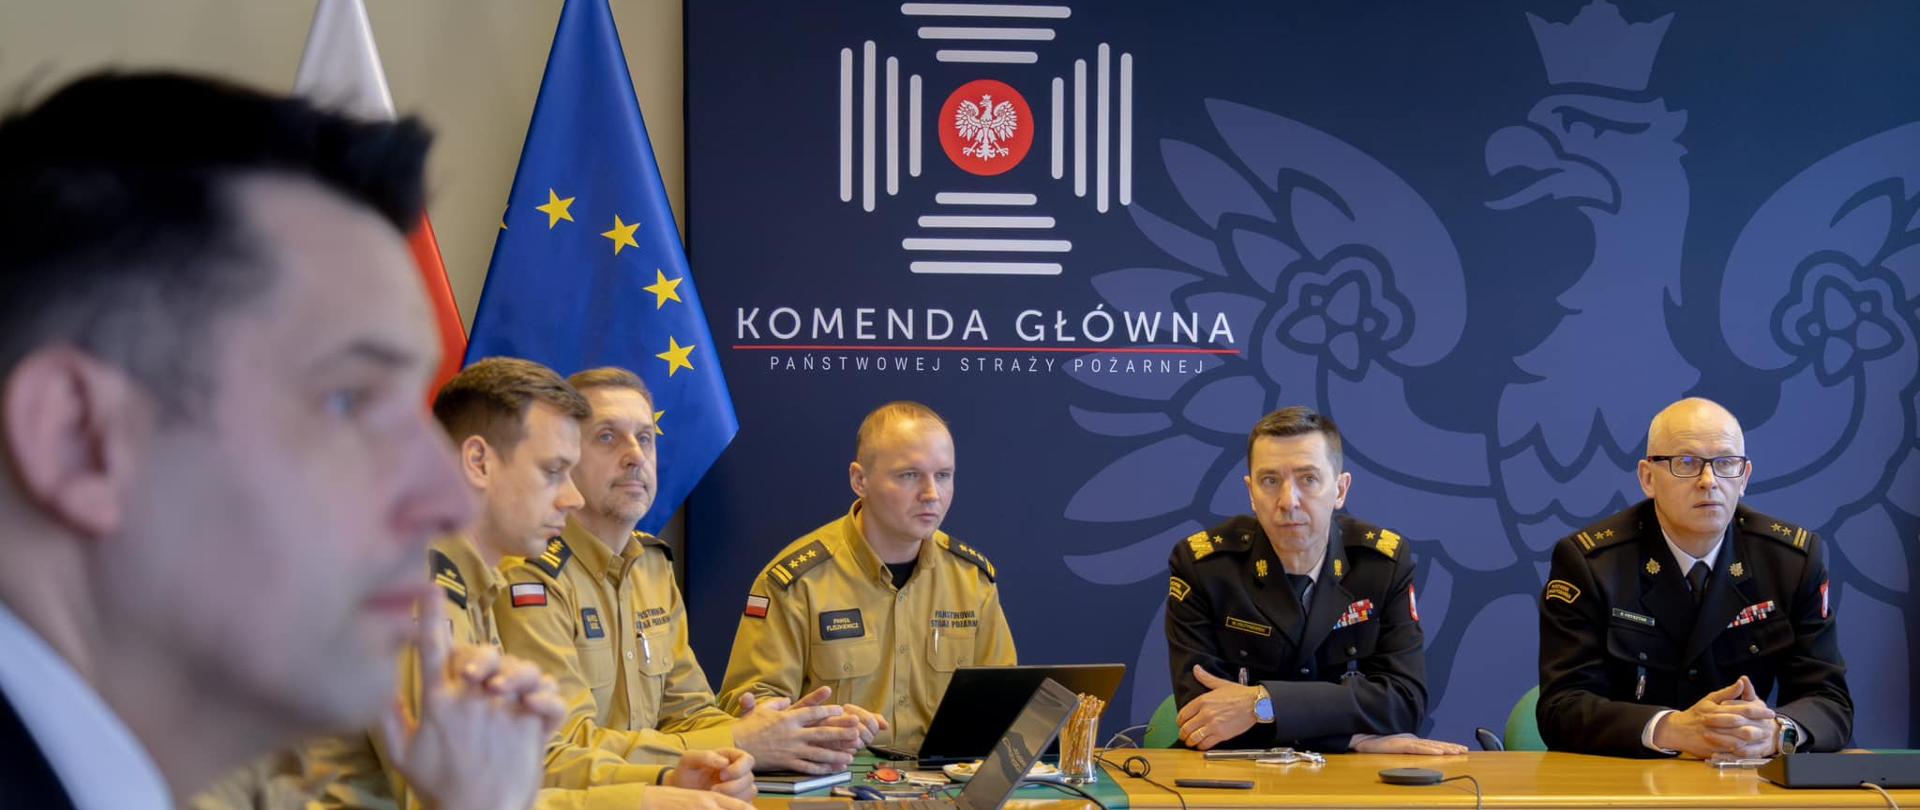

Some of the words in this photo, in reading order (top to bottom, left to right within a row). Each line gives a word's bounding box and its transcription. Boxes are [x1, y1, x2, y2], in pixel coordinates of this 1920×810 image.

[738, 307, 989, 341] KOMENDA
[1015, 303, 1235, 344] GŁÓWNA
[770, 353, 942, 372] PAŃSTWOWEJ
[960, 356, 1055, 373] STRAŻY
[1074, 356, 1204, 375] POŻARNEJ
